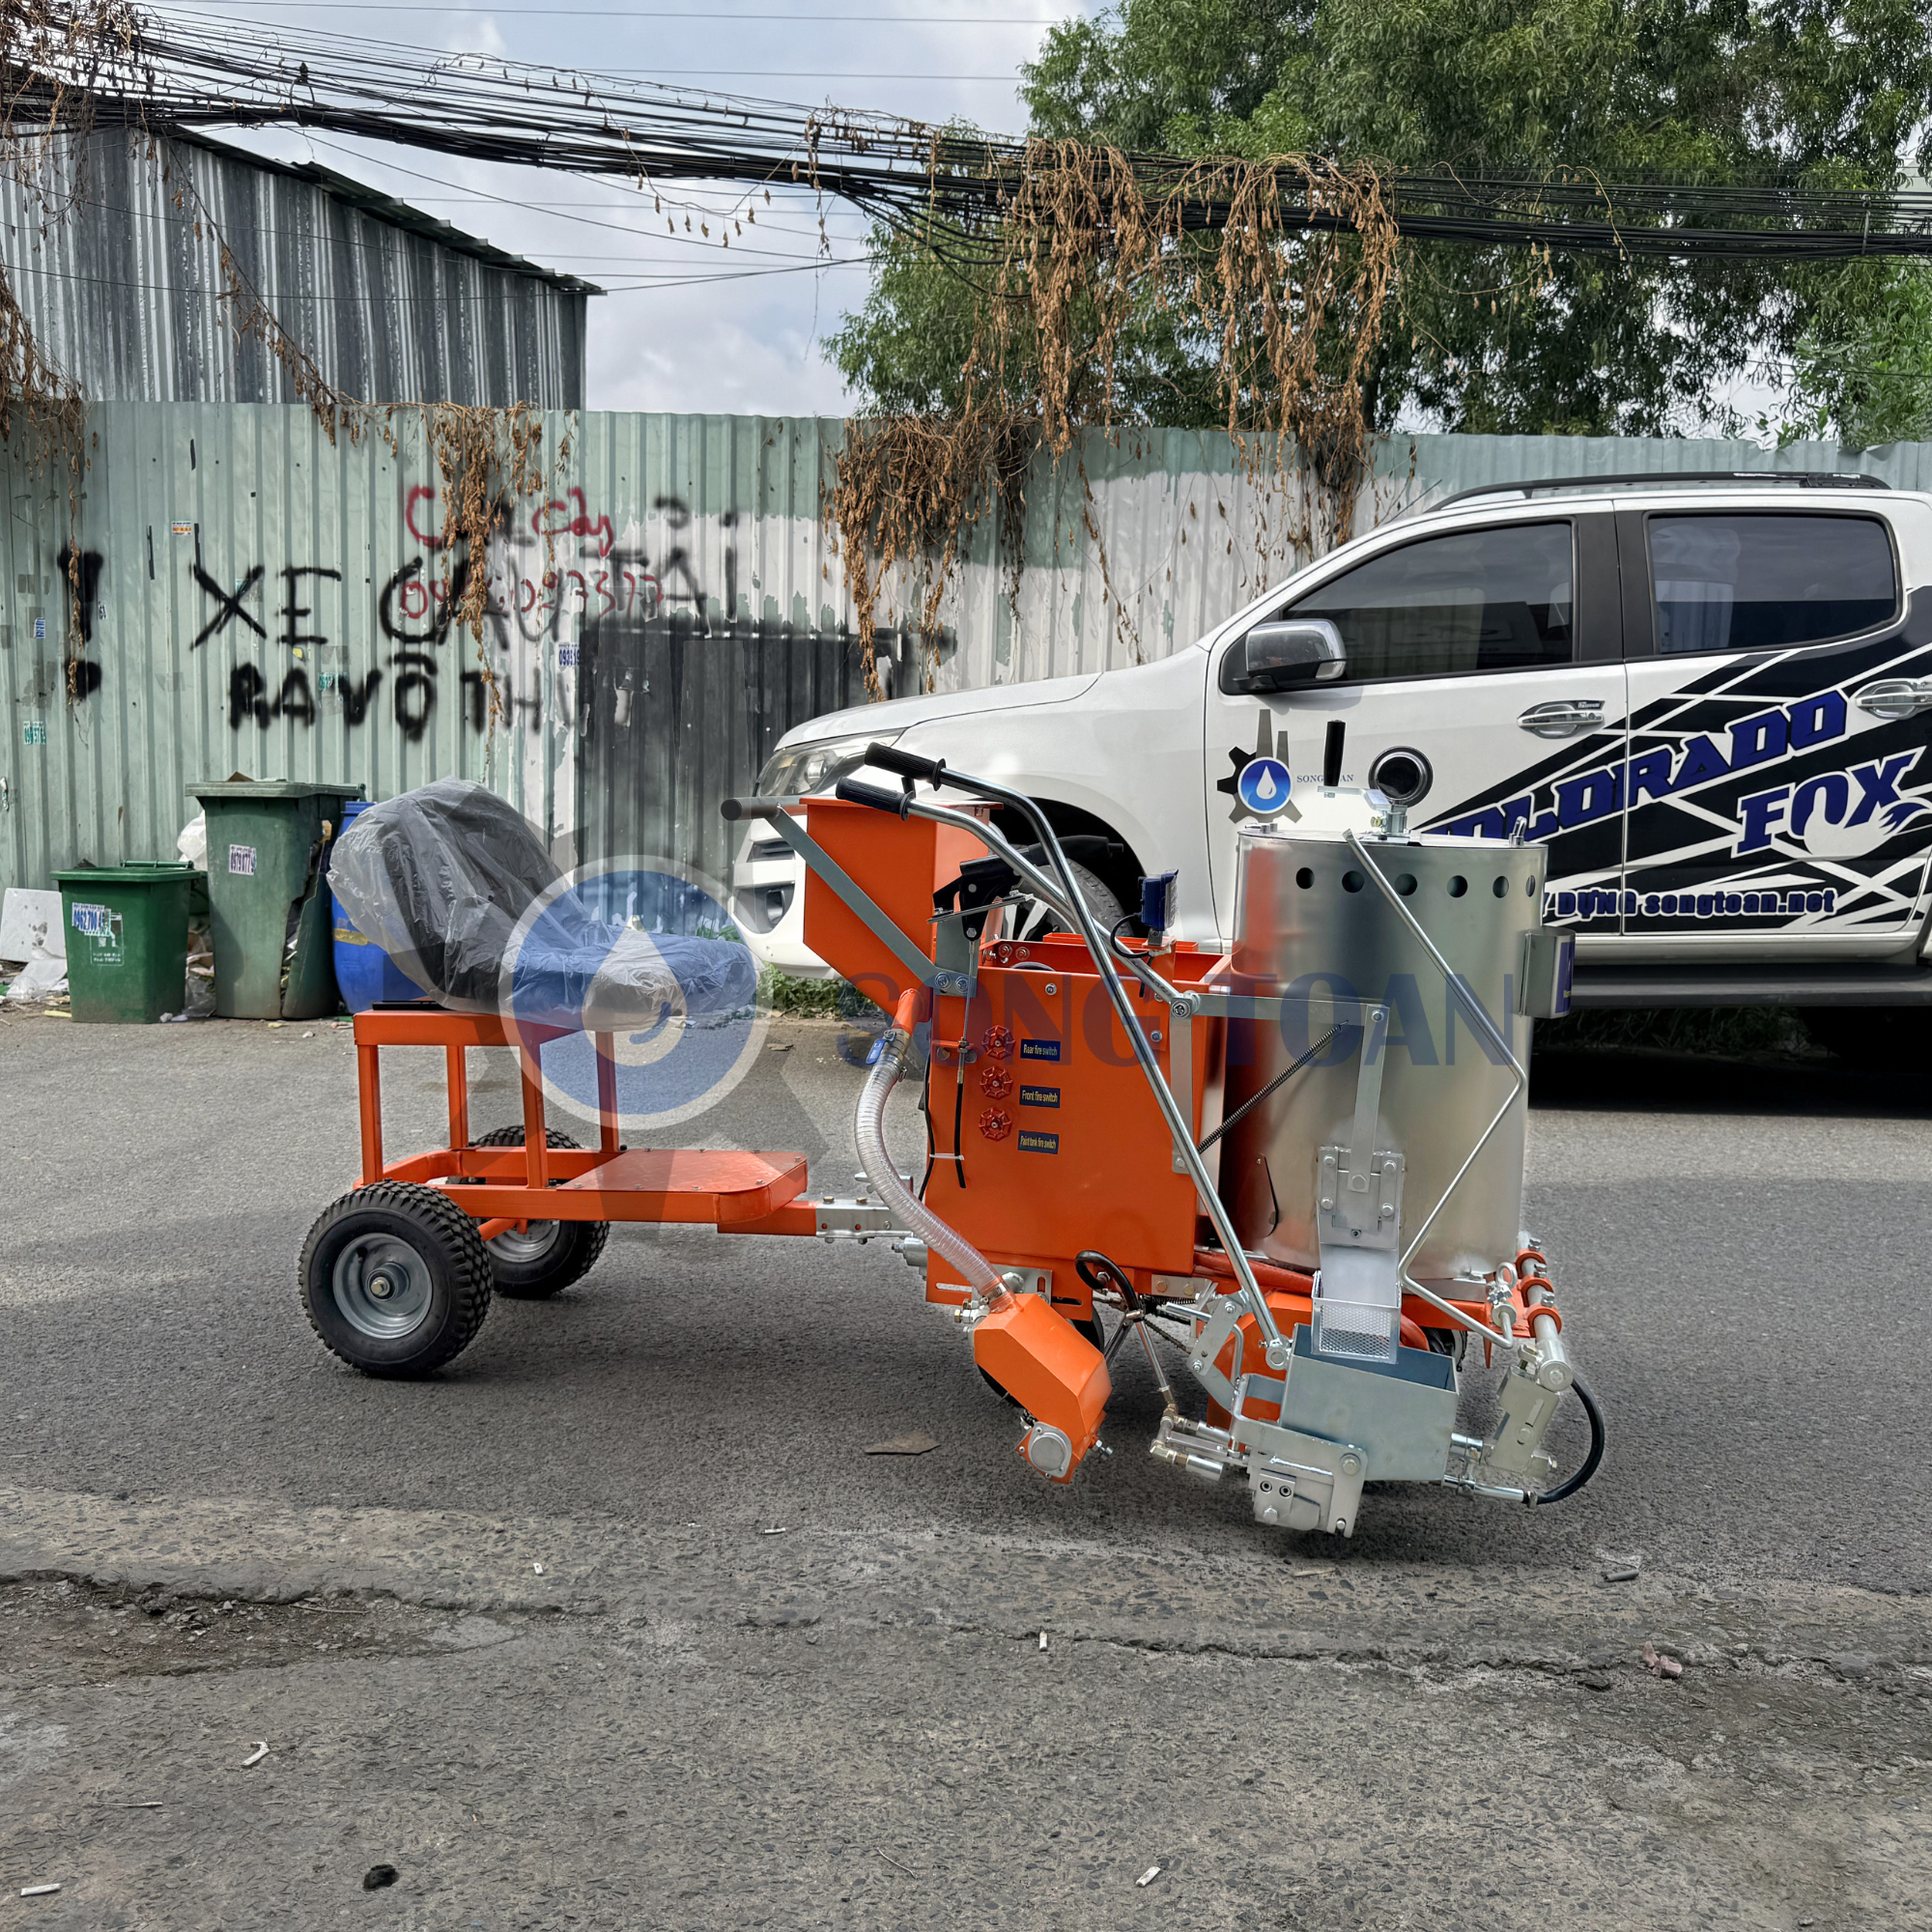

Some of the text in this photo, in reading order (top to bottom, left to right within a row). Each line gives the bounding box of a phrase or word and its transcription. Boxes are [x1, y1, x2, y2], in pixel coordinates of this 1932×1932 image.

[190, 564, 342, 652] XE
[1296, 775, 1324, 783] SONG
[1421, 690, 1848, 844] OLORADO
[1738, 753, 1917, 855] FOX
[1557, 890, 1637, 919] DỤNG
[1644, 891, 1834, 917] songtoan.net
[1043, 1047, 1058, 1056] switch
[1022, 1090, 1035, 1101] Front
[1043, 1093, 1058, 1103] switch
